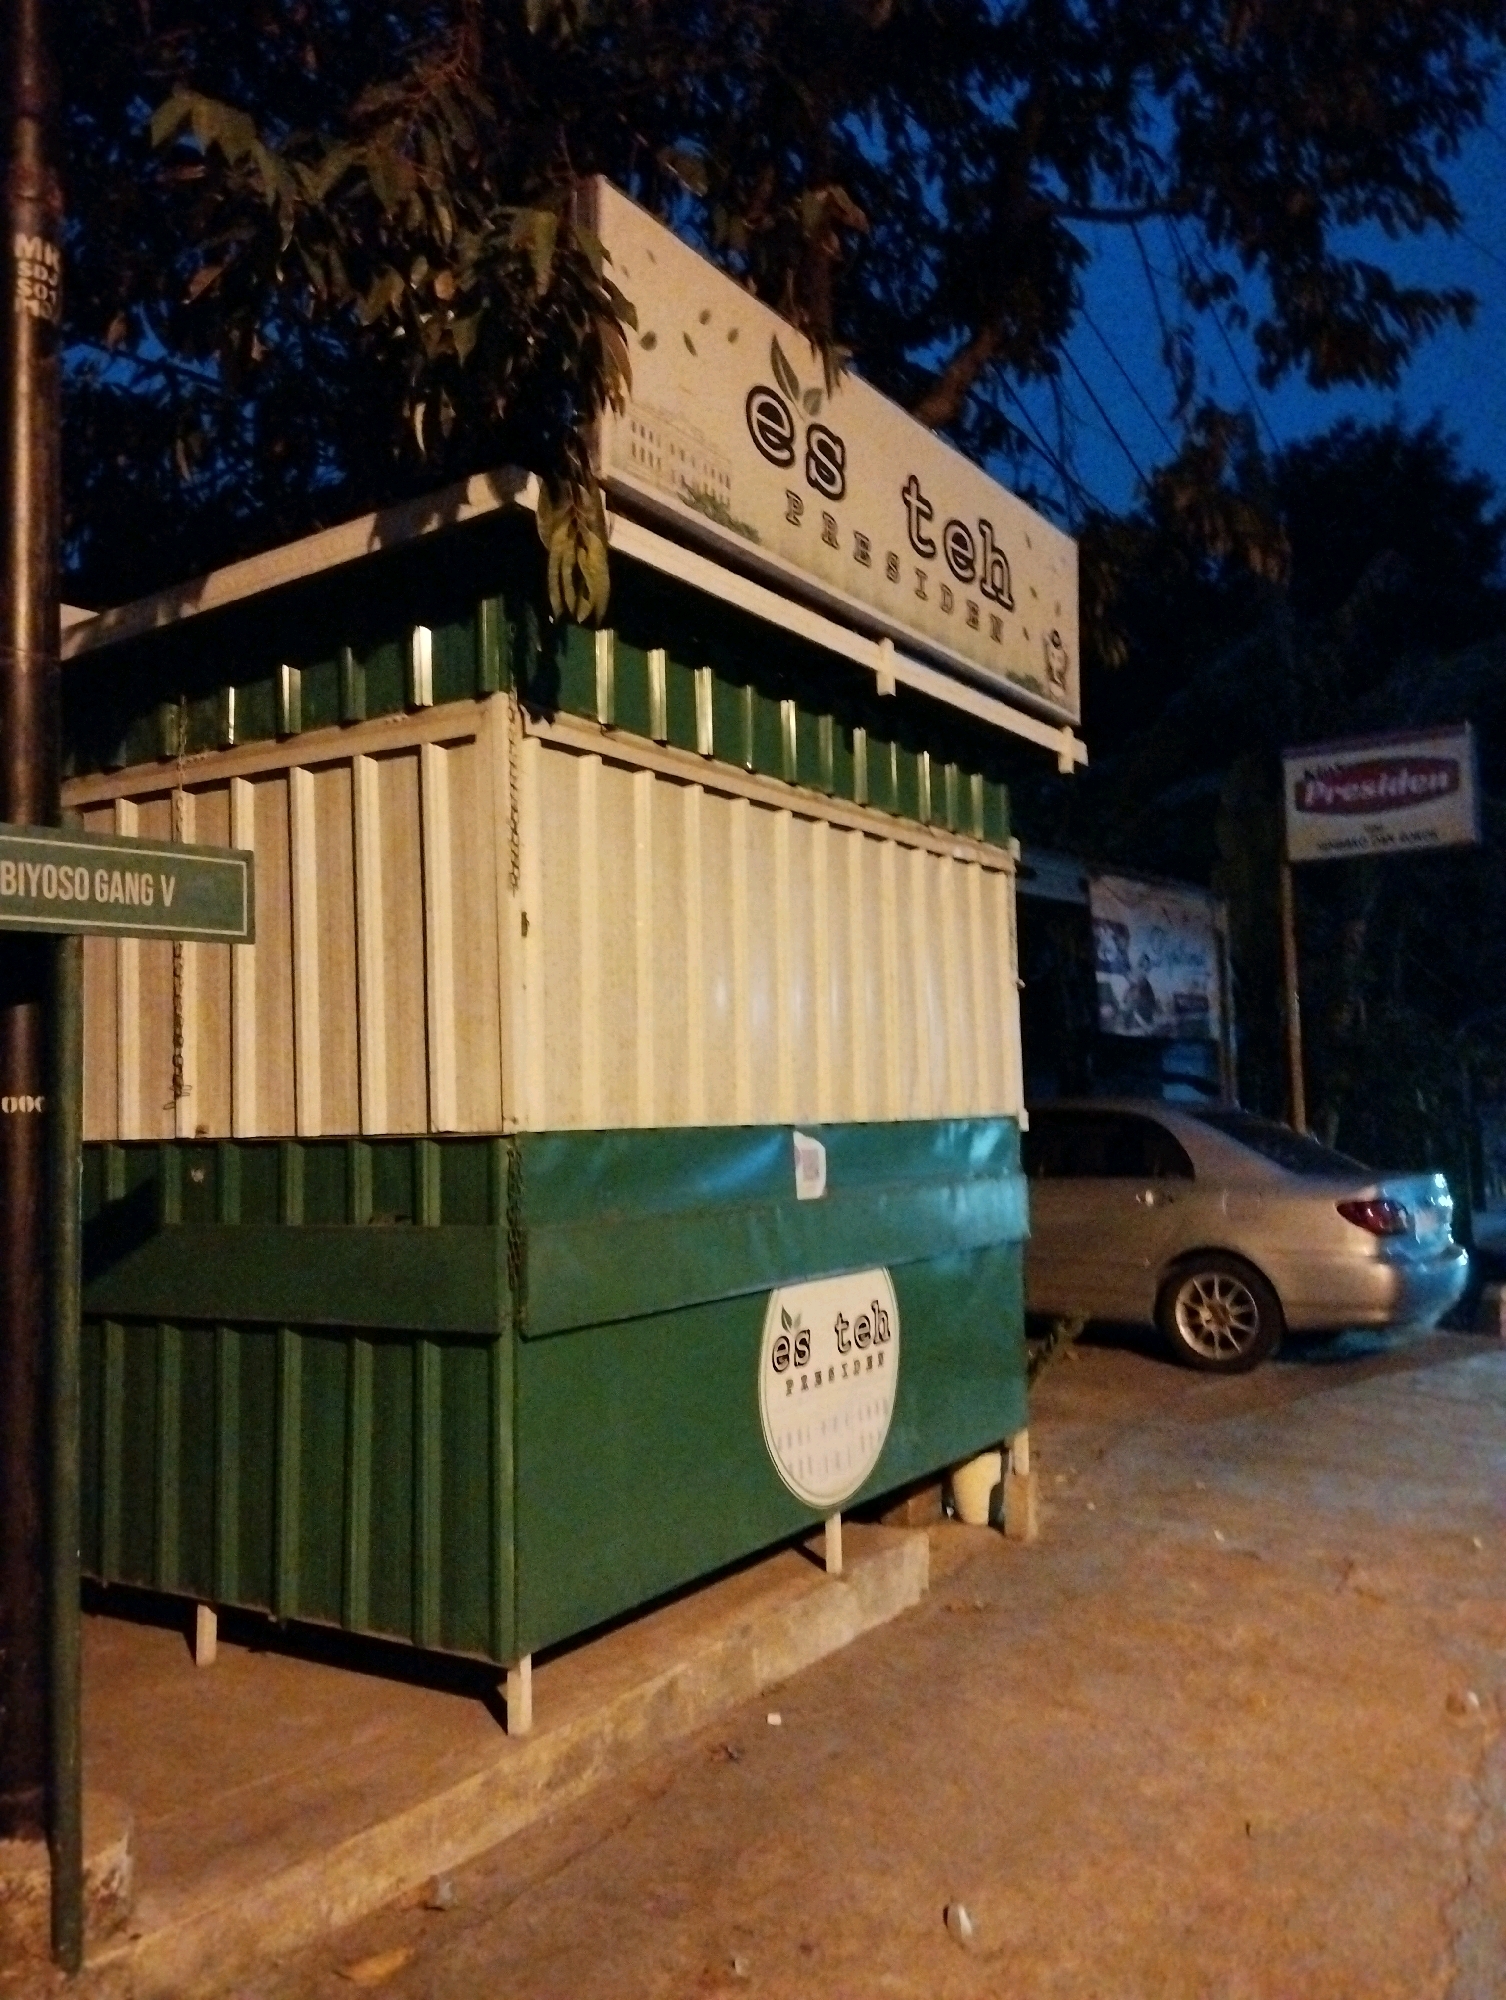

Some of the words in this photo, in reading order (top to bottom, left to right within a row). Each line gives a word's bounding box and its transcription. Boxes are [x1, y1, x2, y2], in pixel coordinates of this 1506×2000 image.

[746, 385, 847, 501] es
[902, 475, 1015, 611] teh
[785, 489, 1004, 643] PRESIDEN
[0, 860, 90, 901] BIYOSO
[94, 868, 154, 906] GANG
[160, 874, 176, 908] V
[771, 1329, 811, 1373] es
[834, 1300, 891, 1354] teh
[785, 1351, 885, 1396] PRESIDEN
